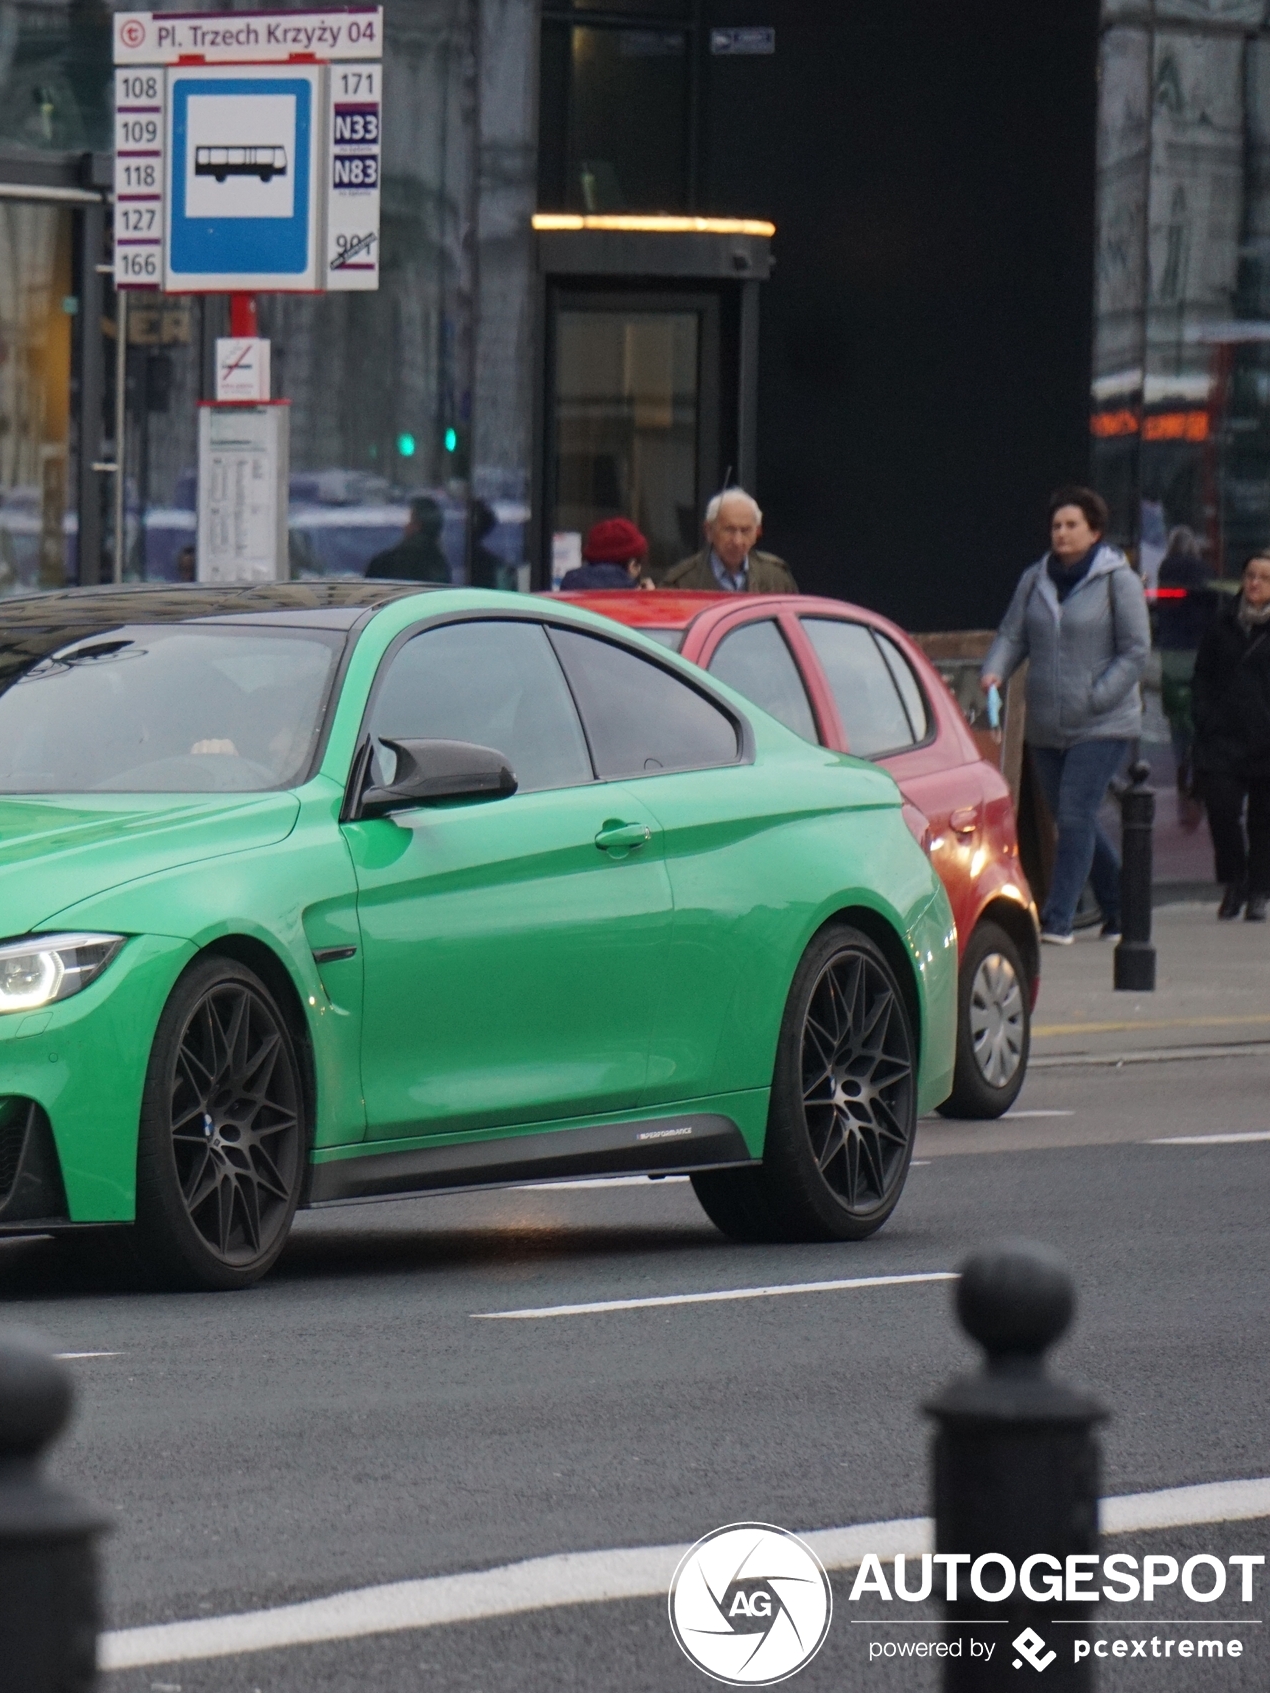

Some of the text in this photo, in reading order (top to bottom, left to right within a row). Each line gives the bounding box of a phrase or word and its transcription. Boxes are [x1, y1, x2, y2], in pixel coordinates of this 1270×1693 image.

[158, 20, 376, 49] Pl. Trzech Krzyży 04
[123, 77, 157, 98] 108
[341, 73, 373, 95] 171
[122, 121, 157, 143] 109
[335, 116, 378, 140] N33
[124, 165, 155, 187] 118
[335, 159, 377, 184] N83
[122, 210, 156, 232] 127
[122, 254, 156, 275] 166
